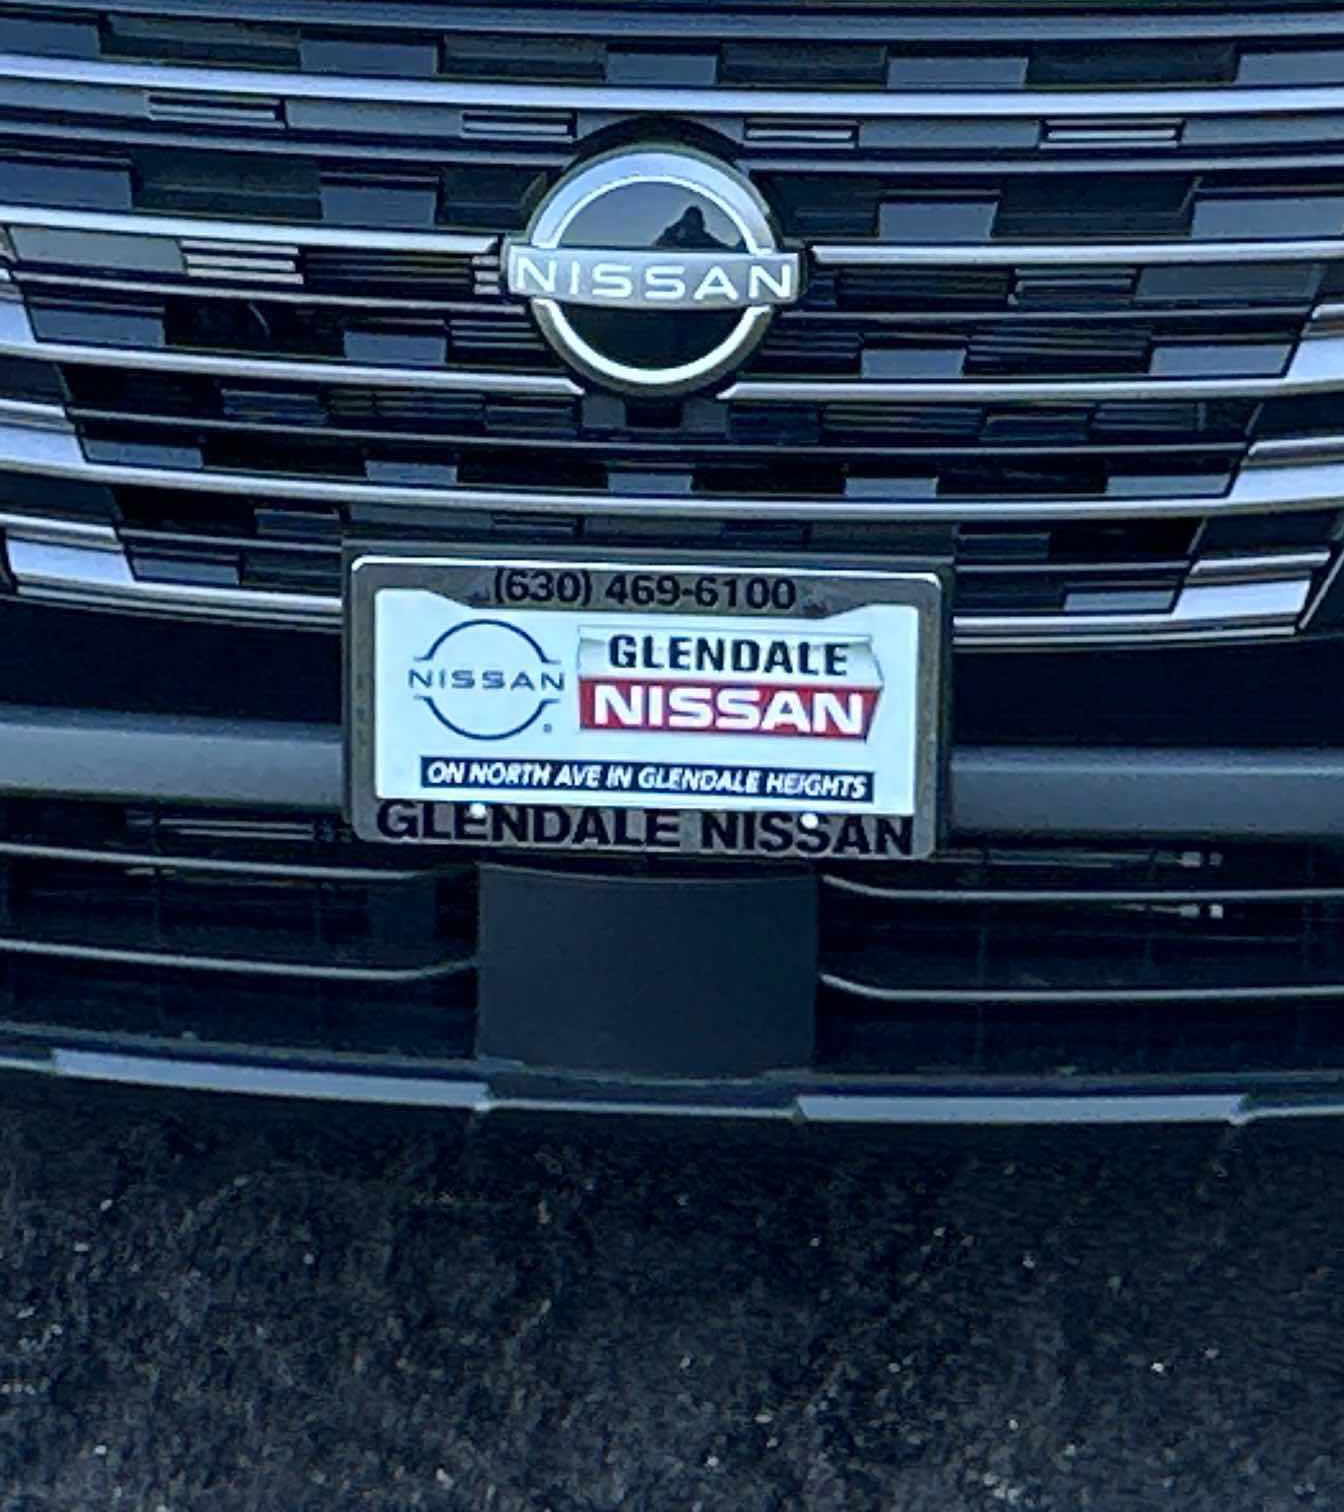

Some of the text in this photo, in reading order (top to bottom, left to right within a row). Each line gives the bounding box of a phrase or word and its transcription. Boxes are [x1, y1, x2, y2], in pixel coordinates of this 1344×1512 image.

[515, 256, 791, 299] NISSAN
[494, 567, 797, 610] (630) 469-6100
[609, 634, 849, 676] GLENDALE
[408, 668, 565, 691] NISSAN
[593, 684, 863, 735] NISSAN
[427, 761, 867, 799] ON NORTH AVE IN GLENDALE HEIGHTS
[377, 799, 913, 855] GLENDALE NISSAN
